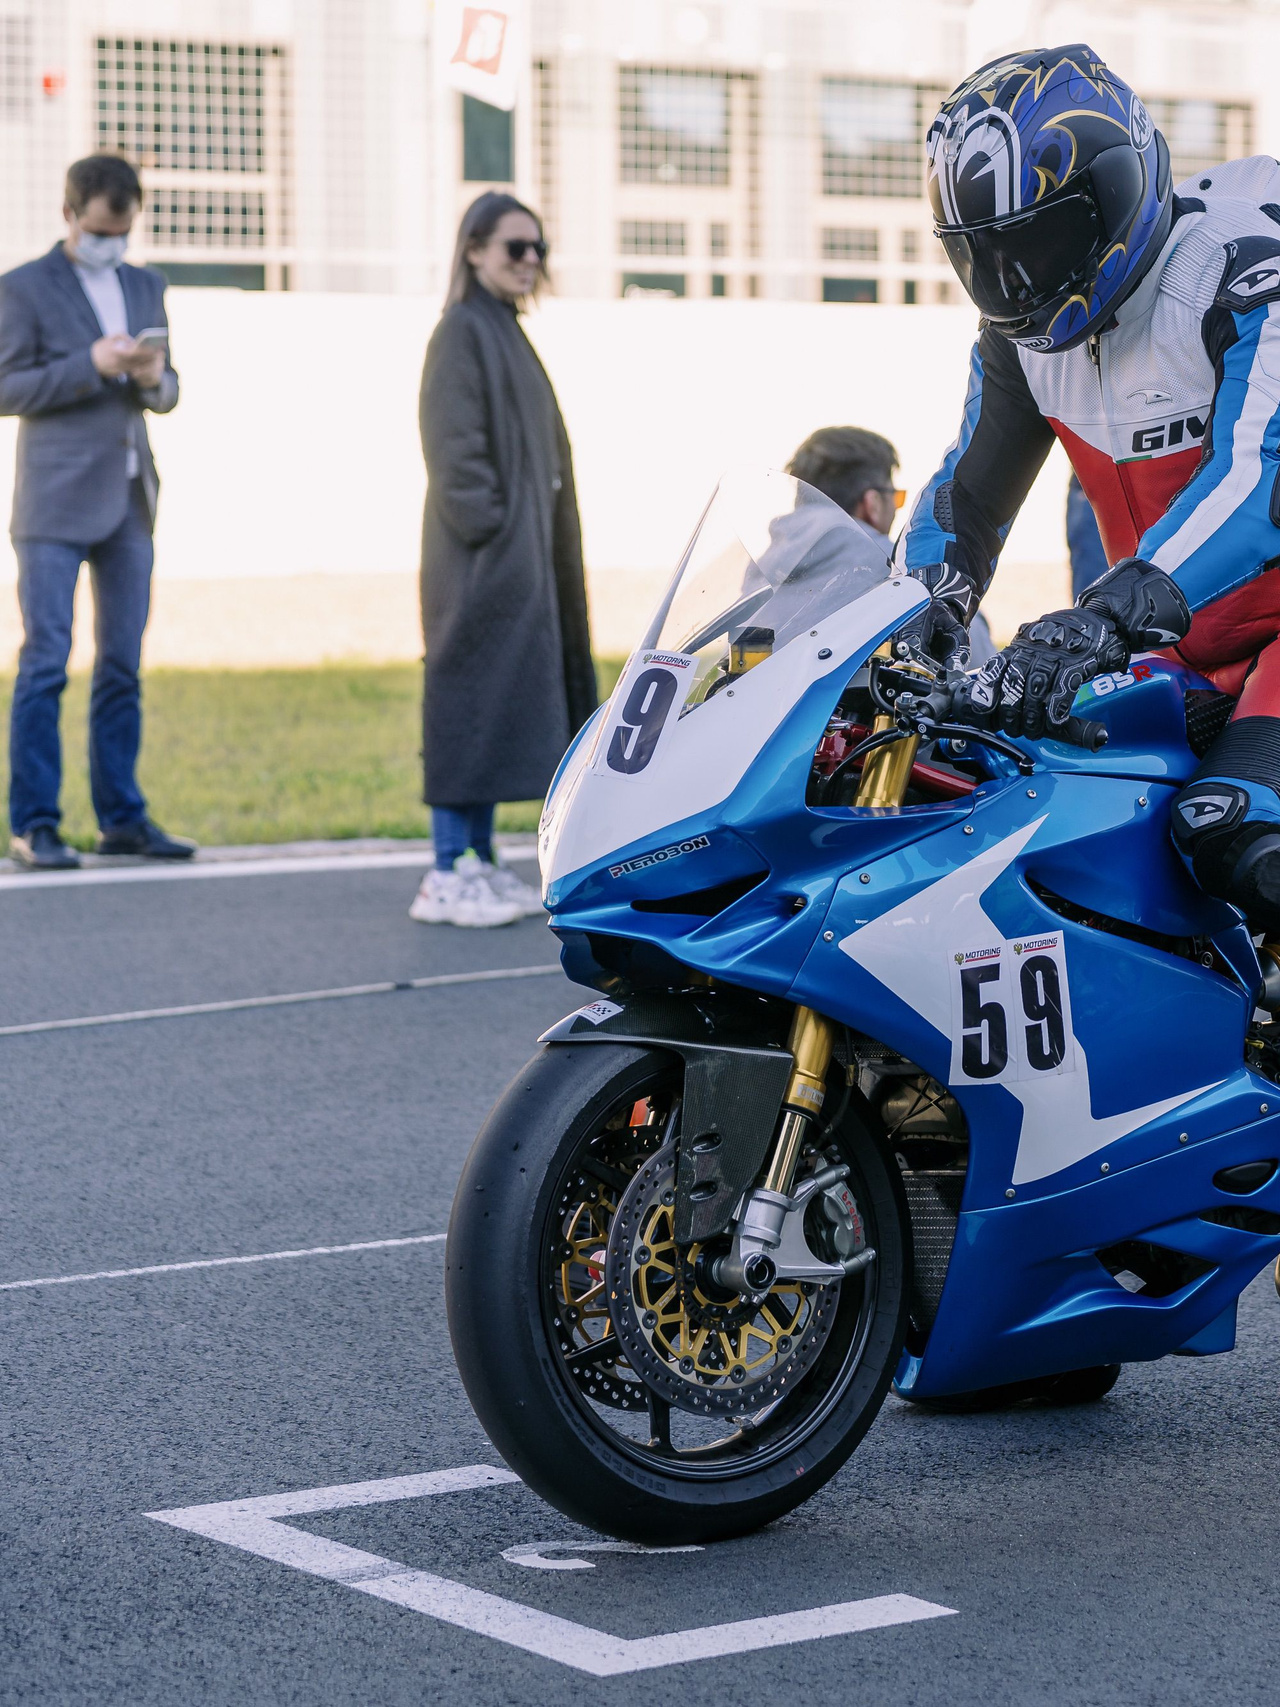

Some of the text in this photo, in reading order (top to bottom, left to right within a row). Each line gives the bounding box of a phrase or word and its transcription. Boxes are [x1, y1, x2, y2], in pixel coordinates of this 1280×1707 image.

[651, 654, 691, 667] MOTORING
[606, 667, 678, 775] 9
[608, 835, 711, 879] PIEROBON
[964, 947, 1001, 960] MOTORING
[1023, 937, 1058, 950] MOTORING
[960, 955, 1067, 1080] 59
[841, 1190, 861, 1245] brembo
